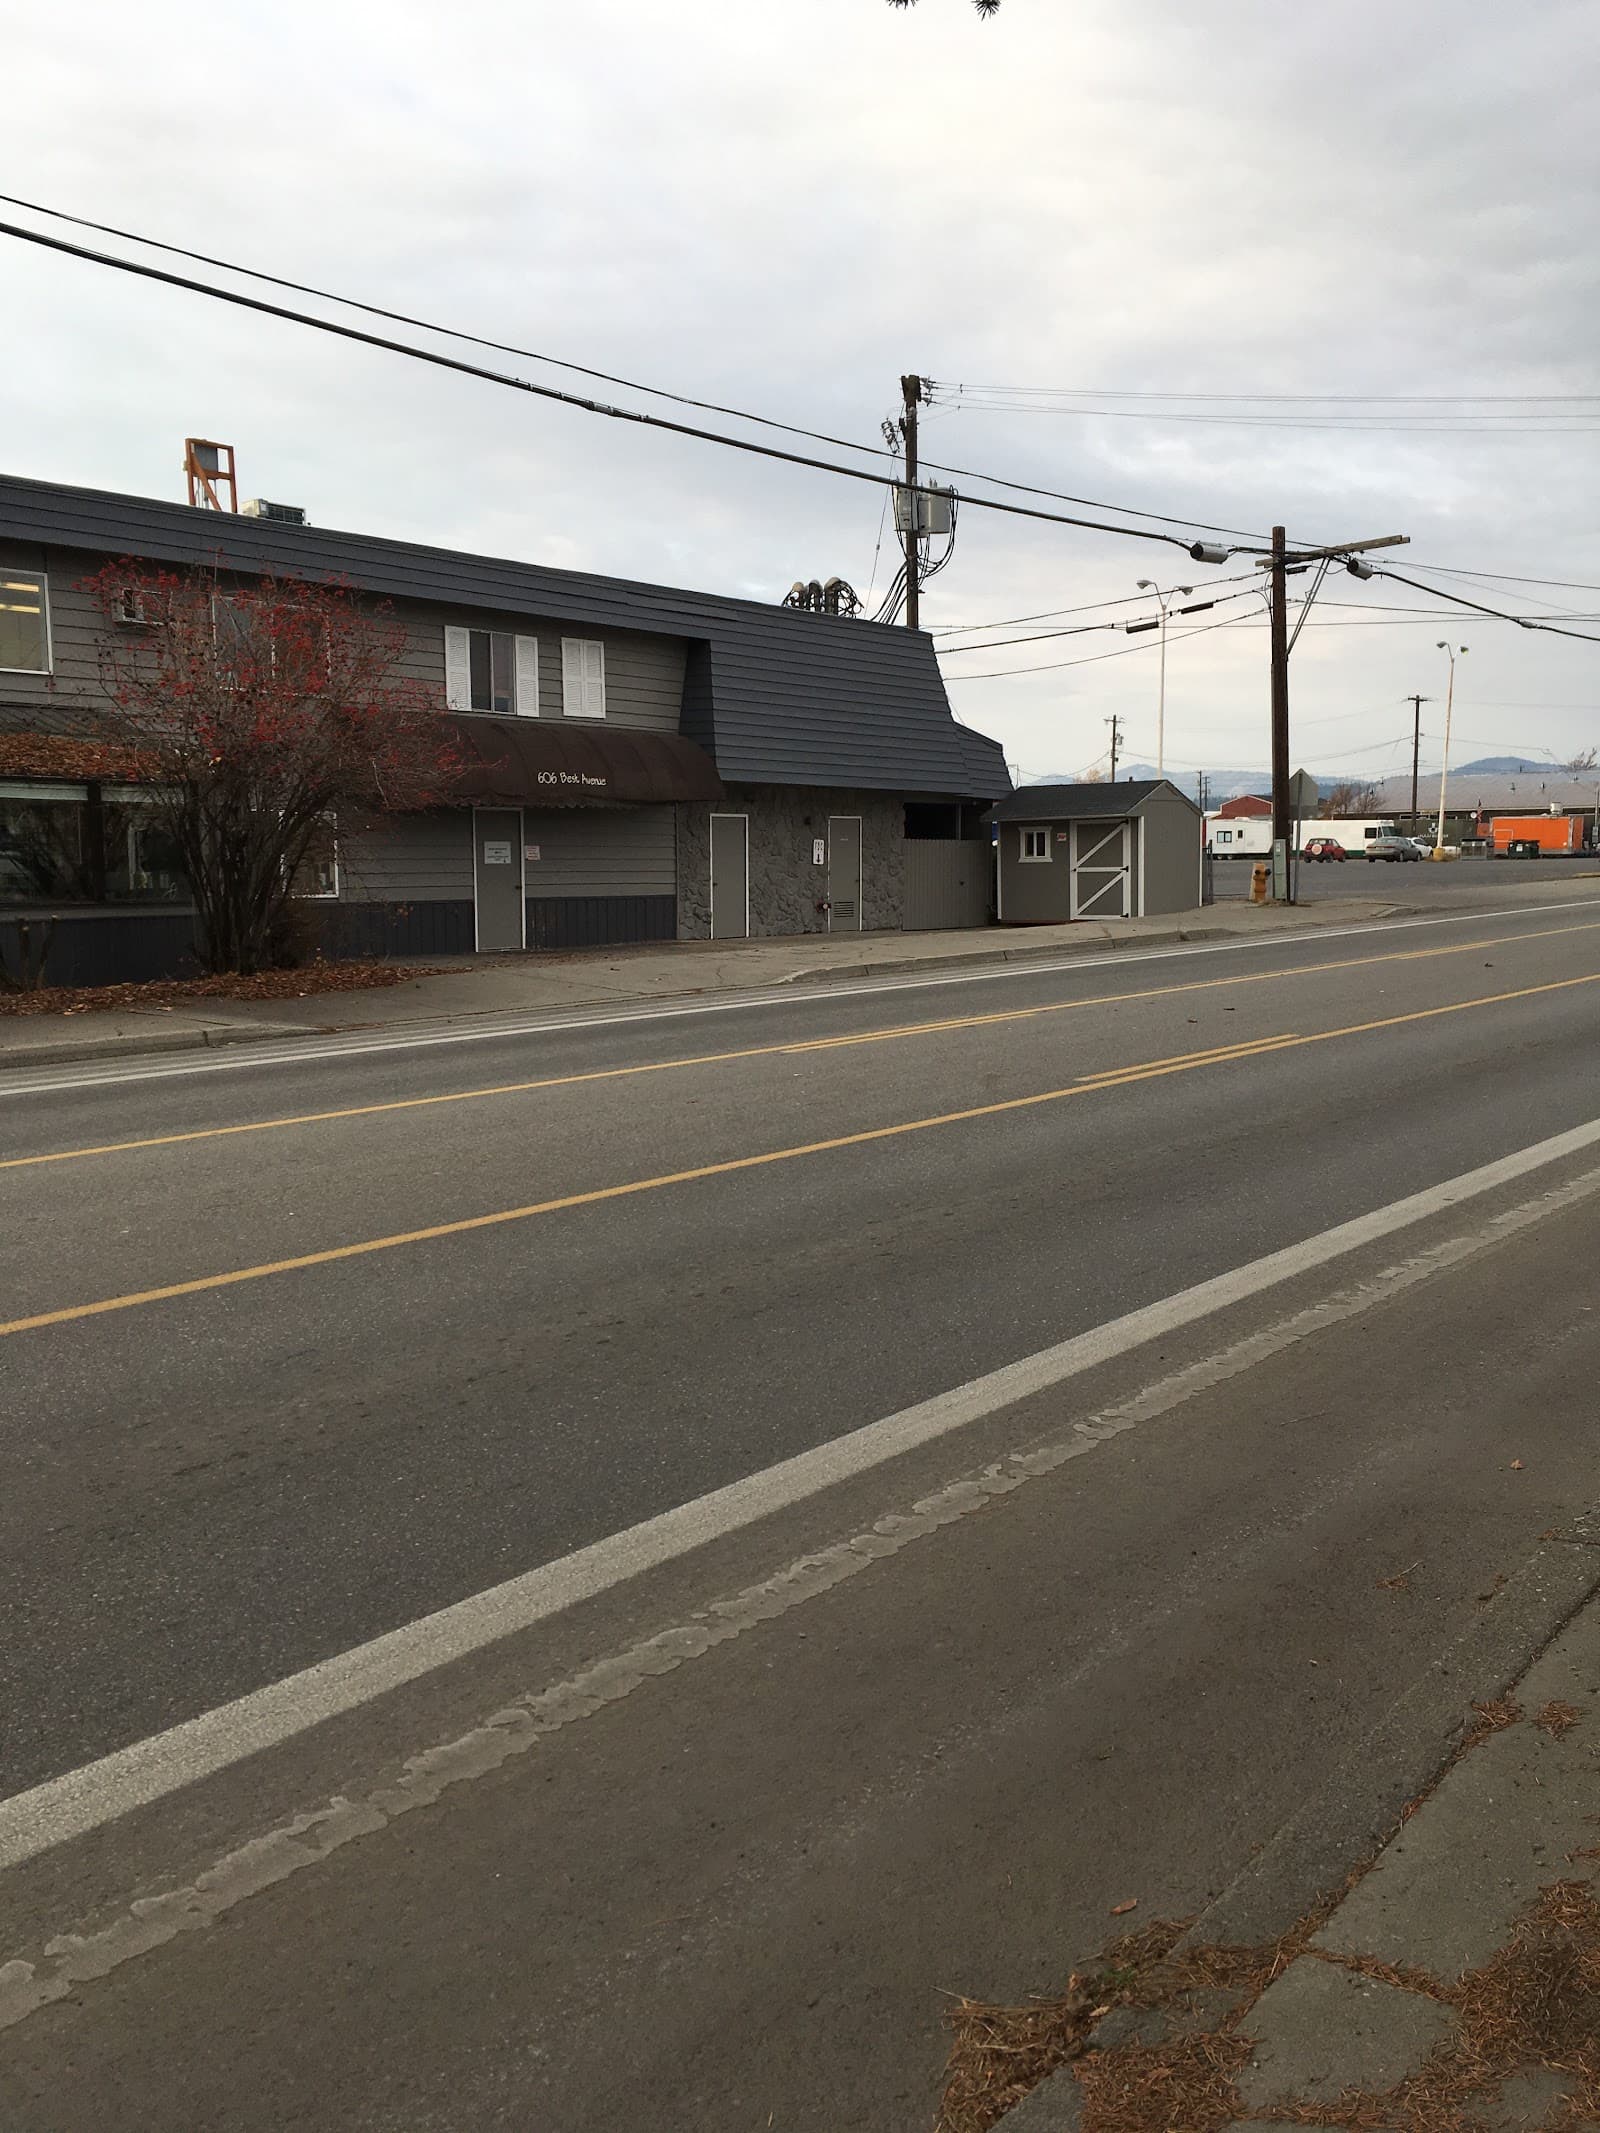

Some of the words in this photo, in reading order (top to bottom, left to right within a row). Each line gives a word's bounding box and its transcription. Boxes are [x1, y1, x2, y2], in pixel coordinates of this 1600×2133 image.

[537, 771, 557, 784] 606
[559, 771, 580, 784] Best
[581, 772, 607, 786] Avenue
